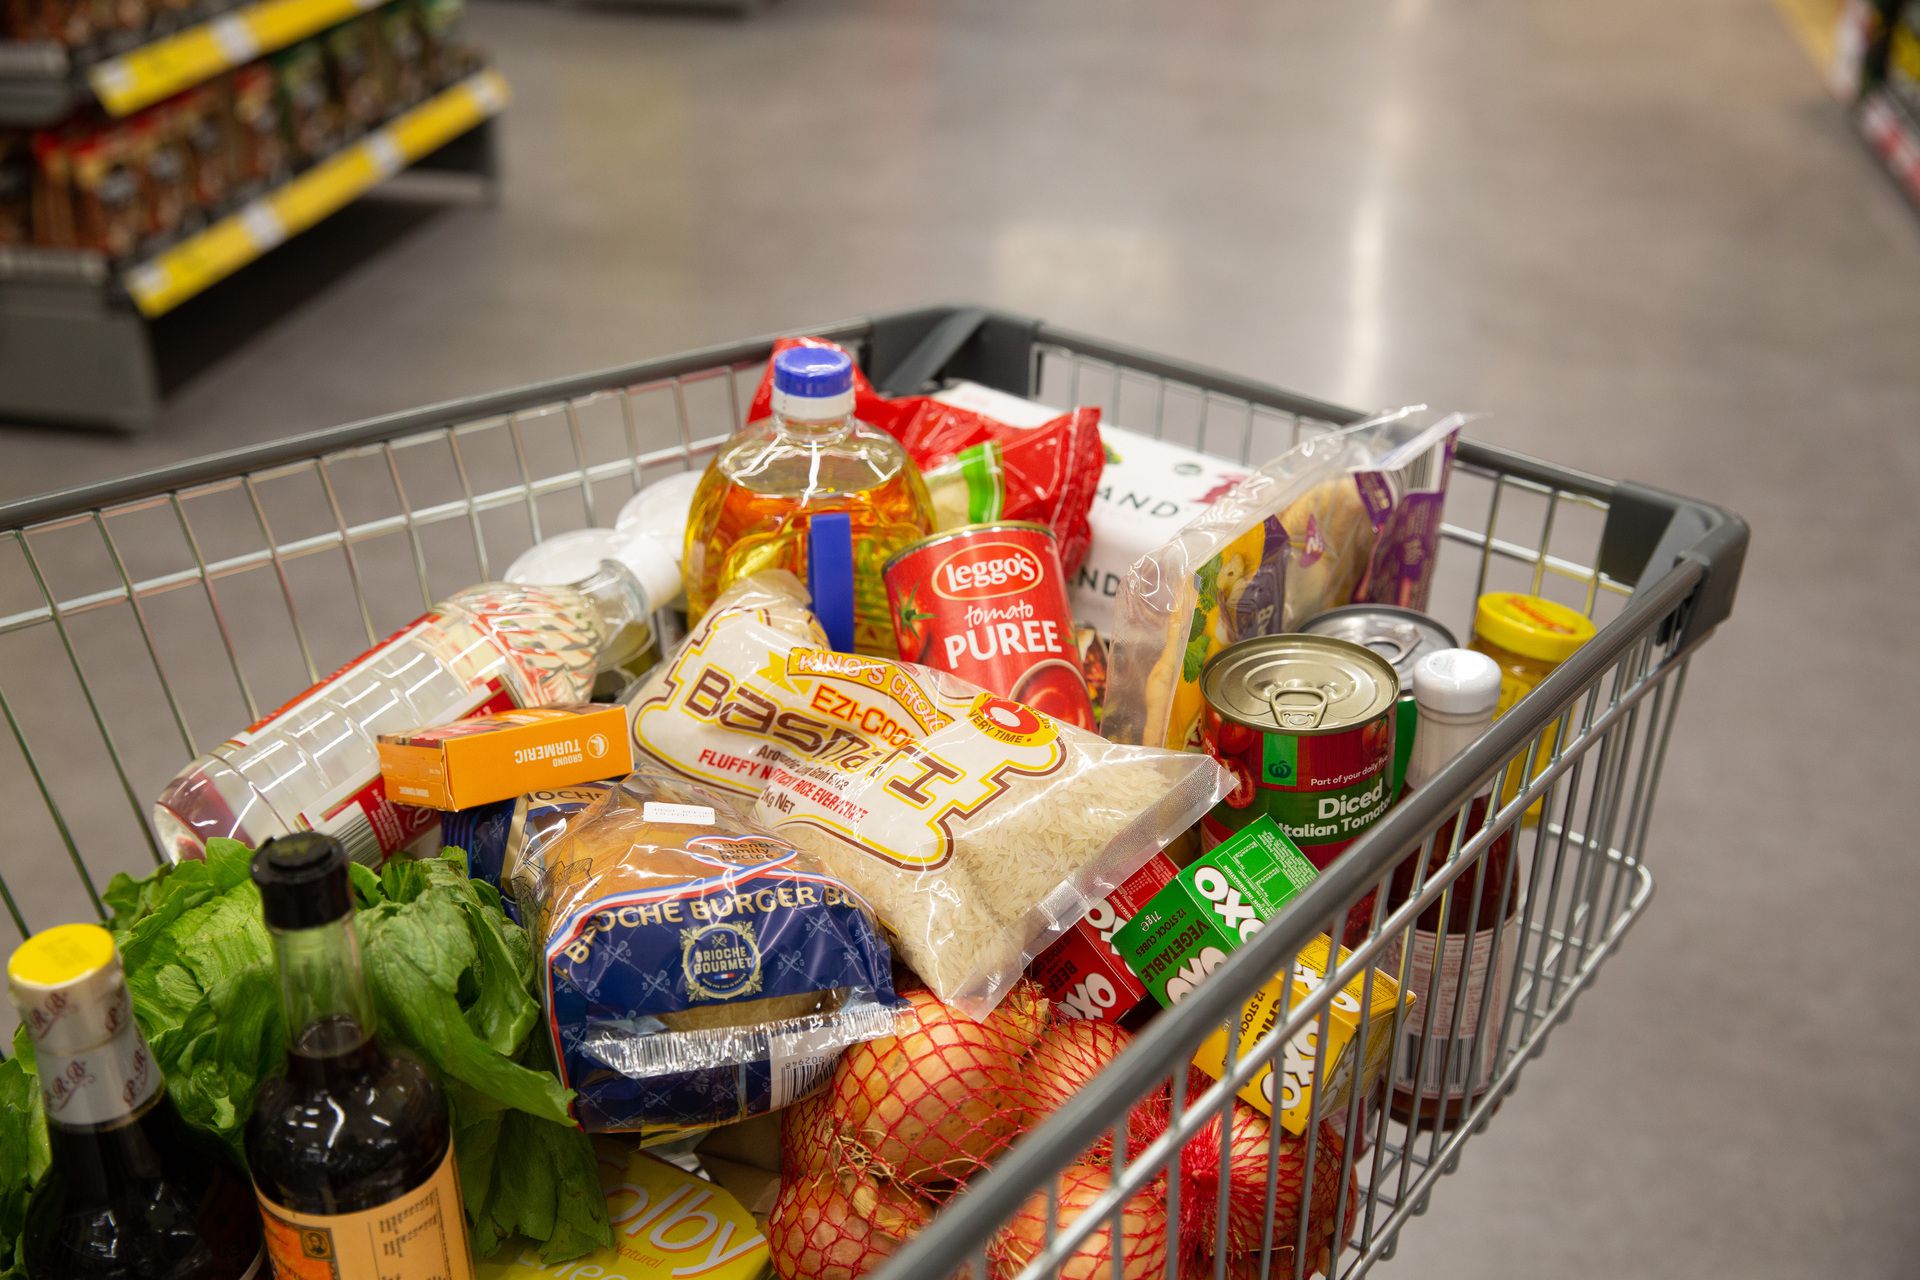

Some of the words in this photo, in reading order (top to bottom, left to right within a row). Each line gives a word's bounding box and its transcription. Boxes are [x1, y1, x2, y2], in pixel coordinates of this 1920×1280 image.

[945, 553, 1036, 593] Leggo's
[964, 599, 1034, 628] tomato
[943, 620, 1062, 670] PUREE
[799, 653, 886, 685] KING'S
[890, 674, 947, 737] CHOIC
[994, 729, 1024, 743] TIME
[513, 738, 583, 765] TURMERIC
[552, 753, 584, 769] GROUND
[698, 748, 760, 777] FLUFFY
[793, 780, 814, 798] RICE
[1310, 777, 1332, 787] Part
[1332, 774, 1343, 784] of
[1343, 771, 1362, 784] your
[1362, 762, 1379, 776] daily
[775, 792, 796, 815] NET
[1317, 776, 1384, 820] Diced
[690, 886, 818, 922] BURGER
[1176, 907, 1187, 920] 12
[1155, 914, 1179, 939] STOCK
[695, 946, 747, 963] BRIOCHE
[1135, 935, 1158, 958] CUBES
[1140, 918, 1211, 984] VEGETABLE
[1047, 959, 1079, 993] BEEF
[1165, 946, 1230, 1006] OXO
[1254, 989, 1267, 1003] 12
[1239, 1001, 1260, 1037] STOCK
[615, 1239, 668, 1271] Natural
